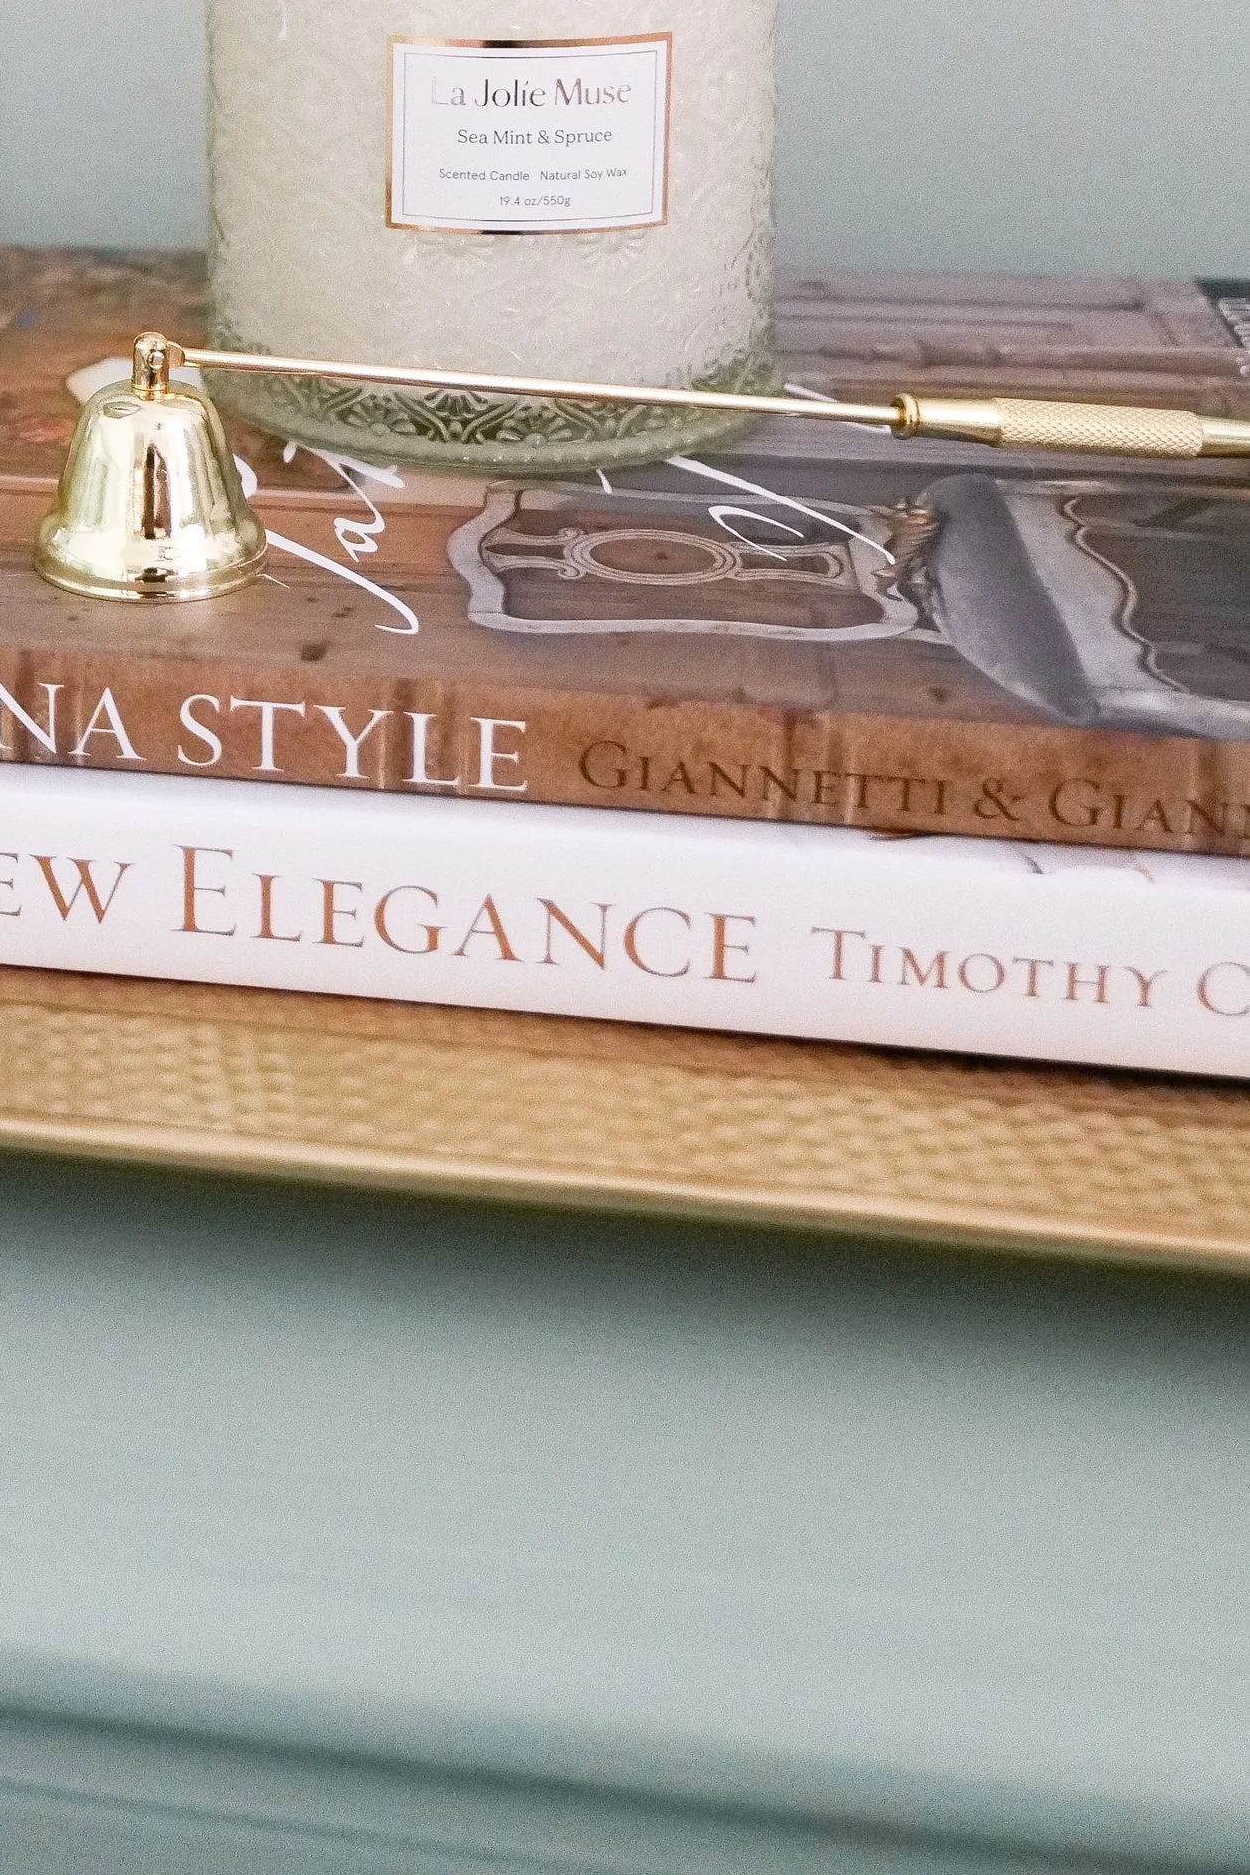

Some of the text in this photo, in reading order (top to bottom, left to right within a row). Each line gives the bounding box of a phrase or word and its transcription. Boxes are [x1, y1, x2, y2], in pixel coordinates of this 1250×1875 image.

[430, 76, 467, 107] La
[555, 78, 632, 106] Muse
[457, 129, 613, 147] Sea Mint & Spruce
[439, 168, 628, 181] Scented Candle Natural Soy Wax
[499, 195, 571, 207] 19.4 oz/550g
[177, 693, 527, 790] STYLE
[972, 779, 1023, 821] &
